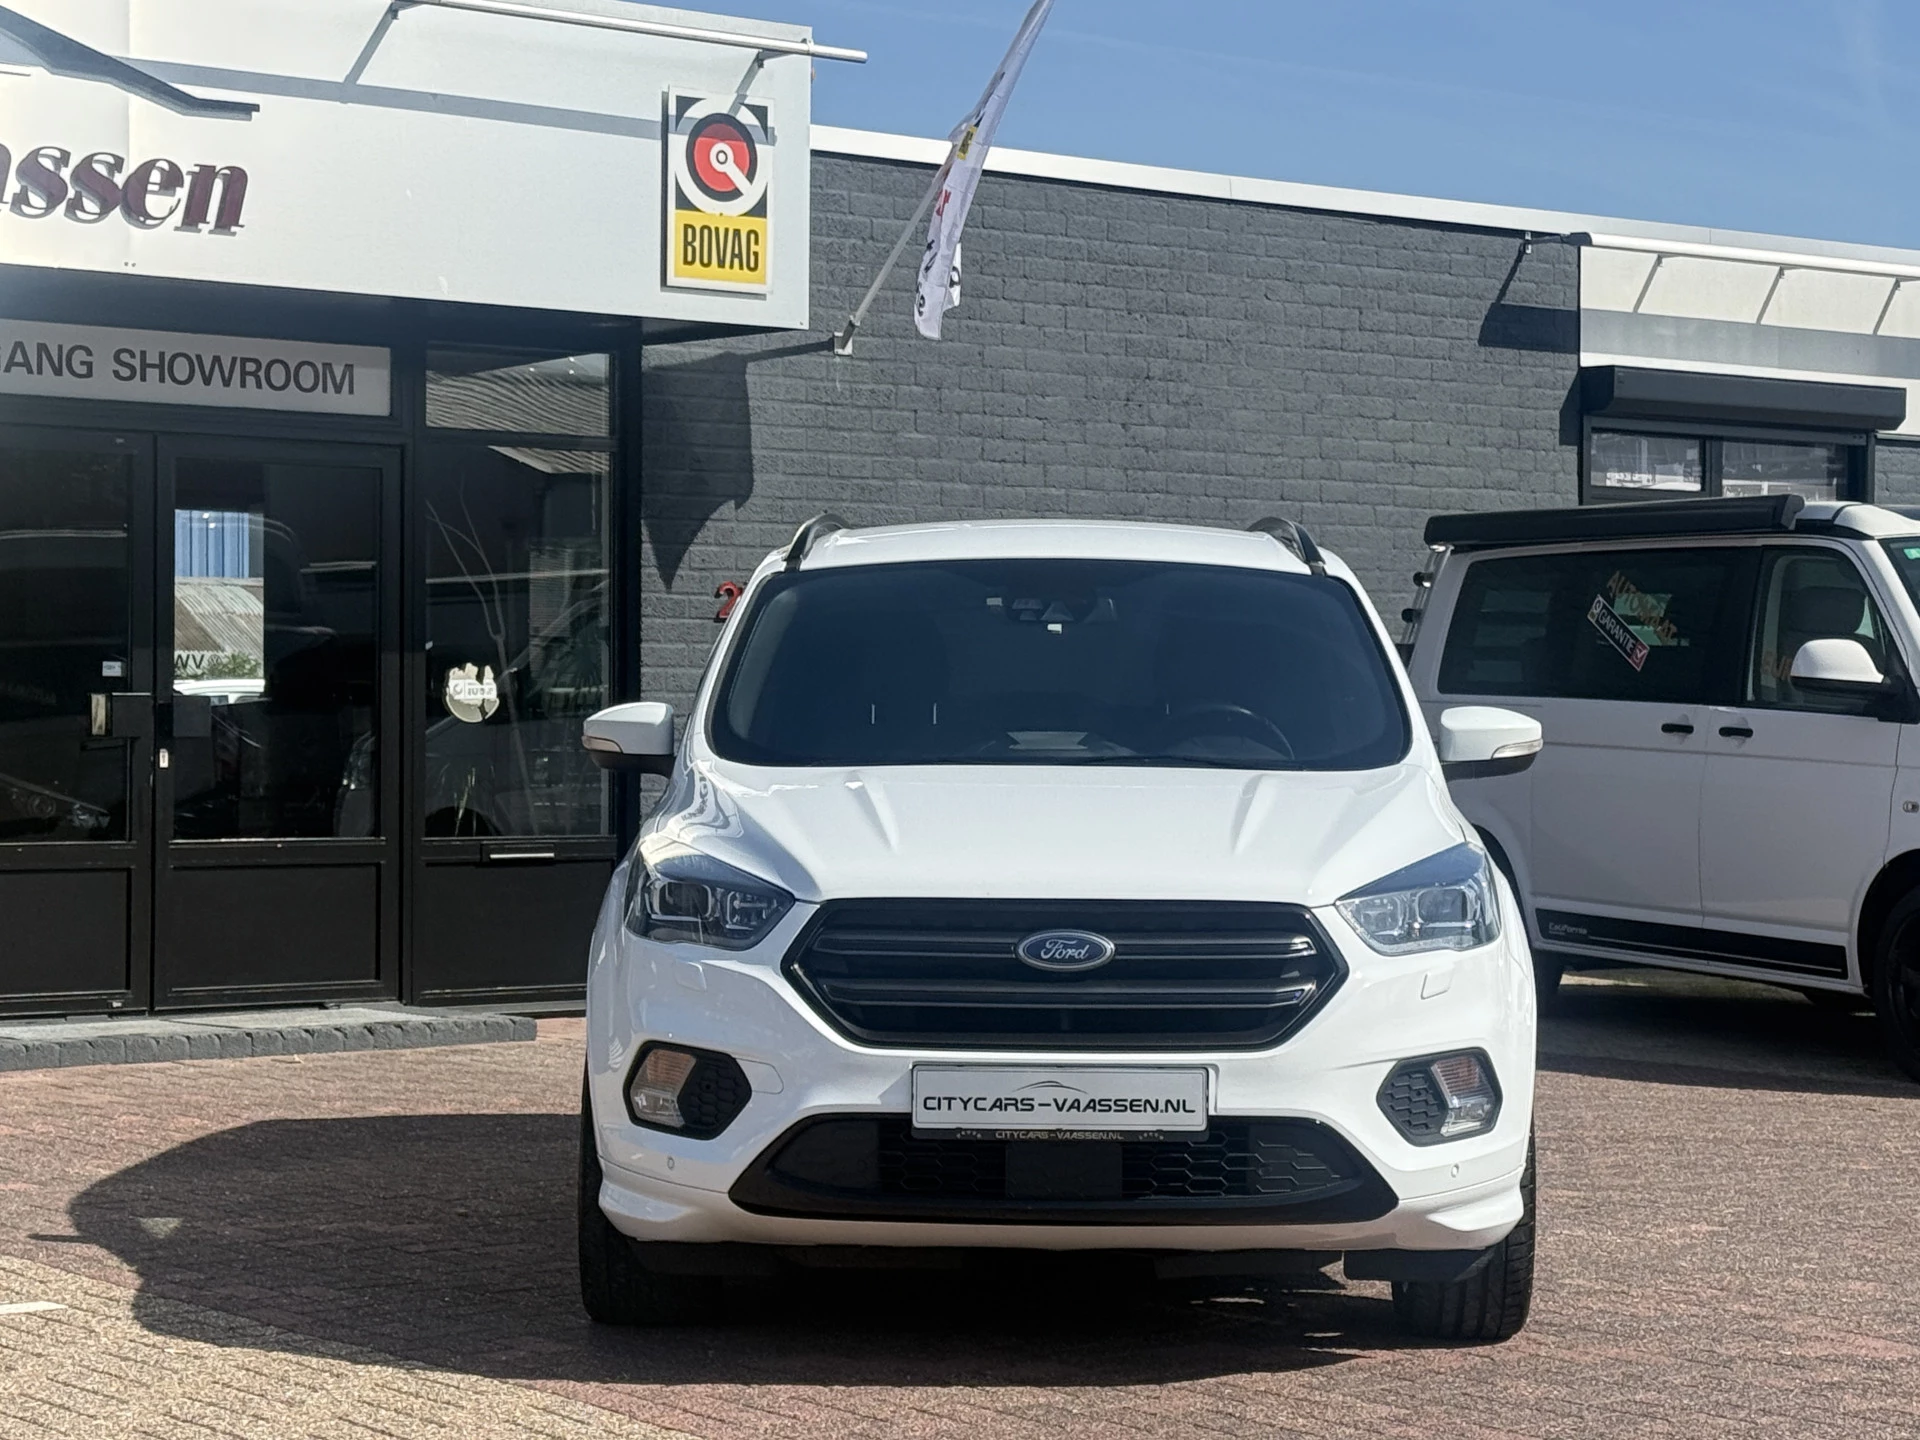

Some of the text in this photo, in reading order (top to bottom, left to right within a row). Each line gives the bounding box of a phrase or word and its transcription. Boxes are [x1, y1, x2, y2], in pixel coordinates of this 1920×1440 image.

[682, 223, 760, 273] BOVAG
[0, 341, 355, 396] ANG SHOWROOM
[1598, 609, 1636, 654] GARANTIE
[1040, 939, 1090, 960] Ford
[922, 1095, 1196, 1114] CITYCARS-VAASSEN.NL
[995, 1131, 1125, 1141] CITYCARS-VAASSEN.NL
